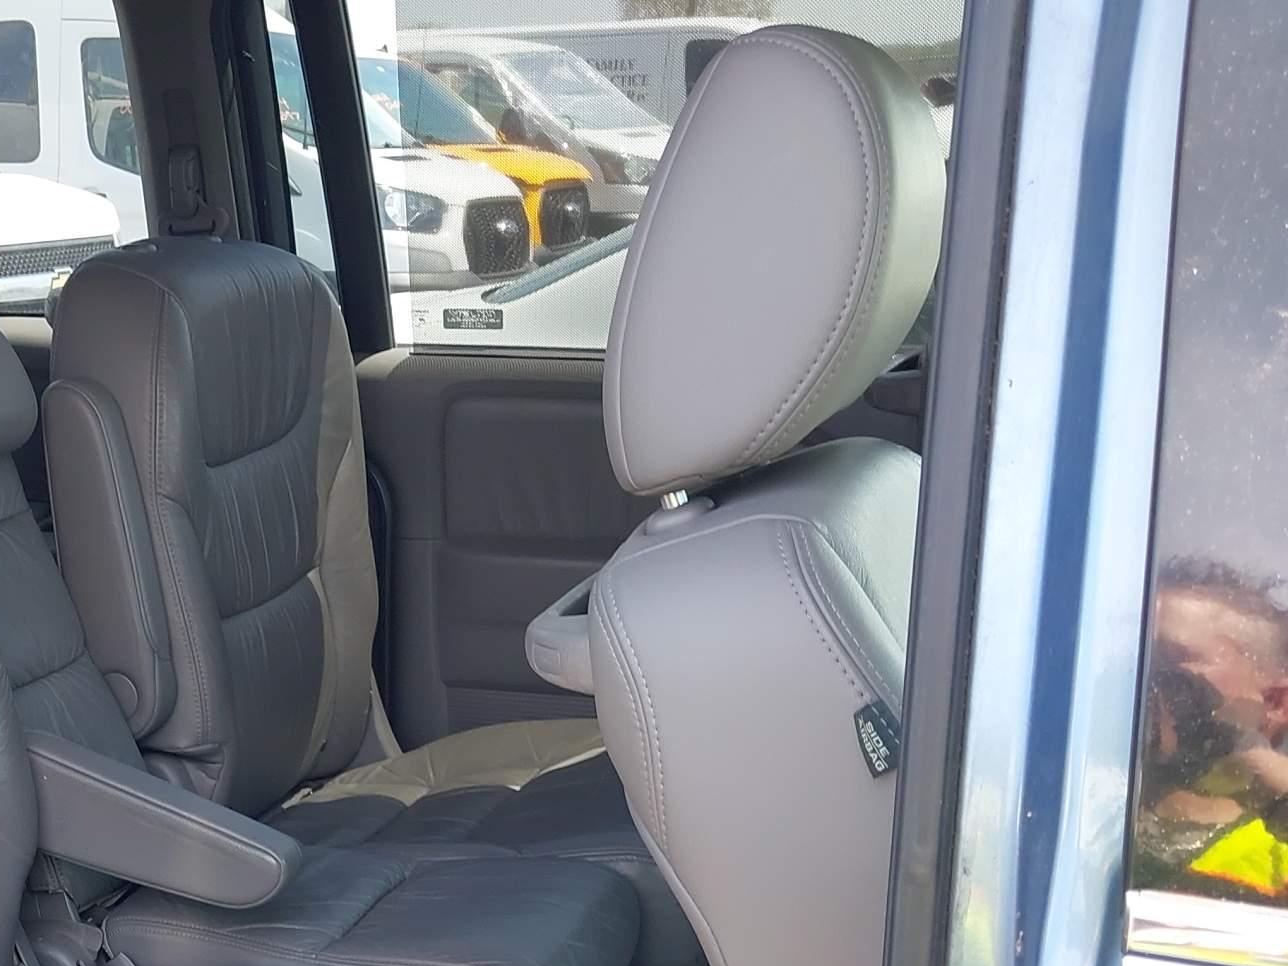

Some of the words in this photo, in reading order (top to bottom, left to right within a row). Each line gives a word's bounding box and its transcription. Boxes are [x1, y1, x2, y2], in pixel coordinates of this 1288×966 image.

[610, 73, 650, 87] CTICE
[857, 717, 885, 772] AIRBAG
[864, 720, 890, 758] SIDE
